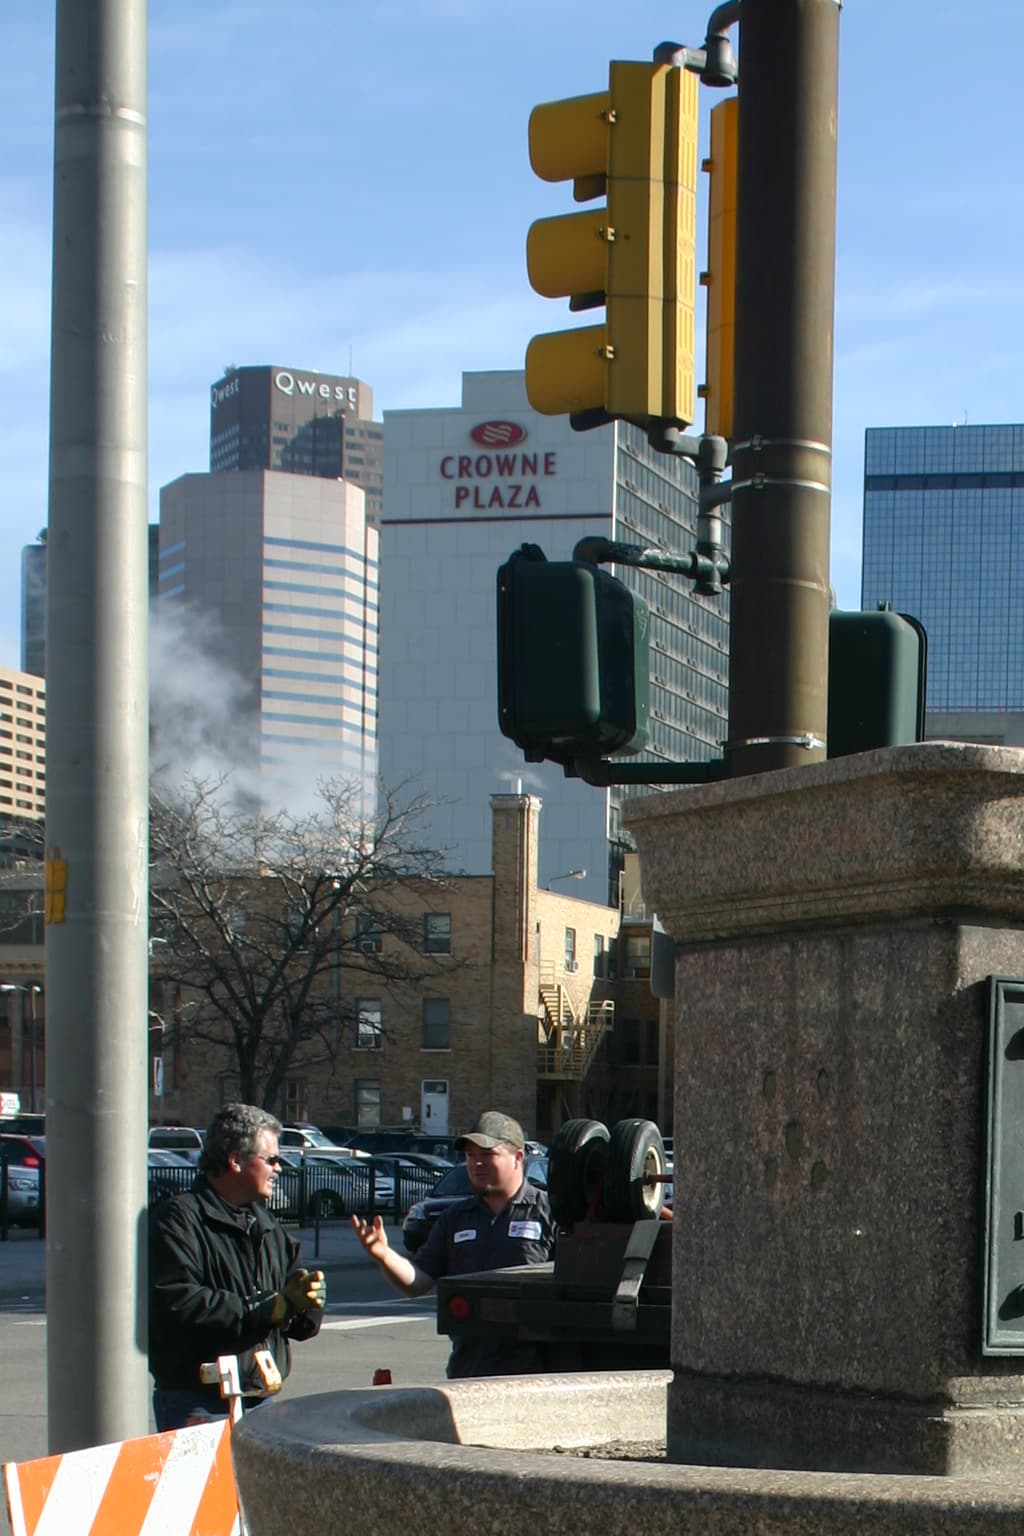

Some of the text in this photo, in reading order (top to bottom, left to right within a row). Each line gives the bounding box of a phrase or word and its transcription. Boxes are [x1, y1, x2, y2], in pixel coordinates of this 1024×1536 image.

[212, 378, 240, 409] Qwest
[275, 371, 357, 402] Qwest
[440, 452, 556, 479] CROWNE
[455, 485, 541, 509] PLAZA
